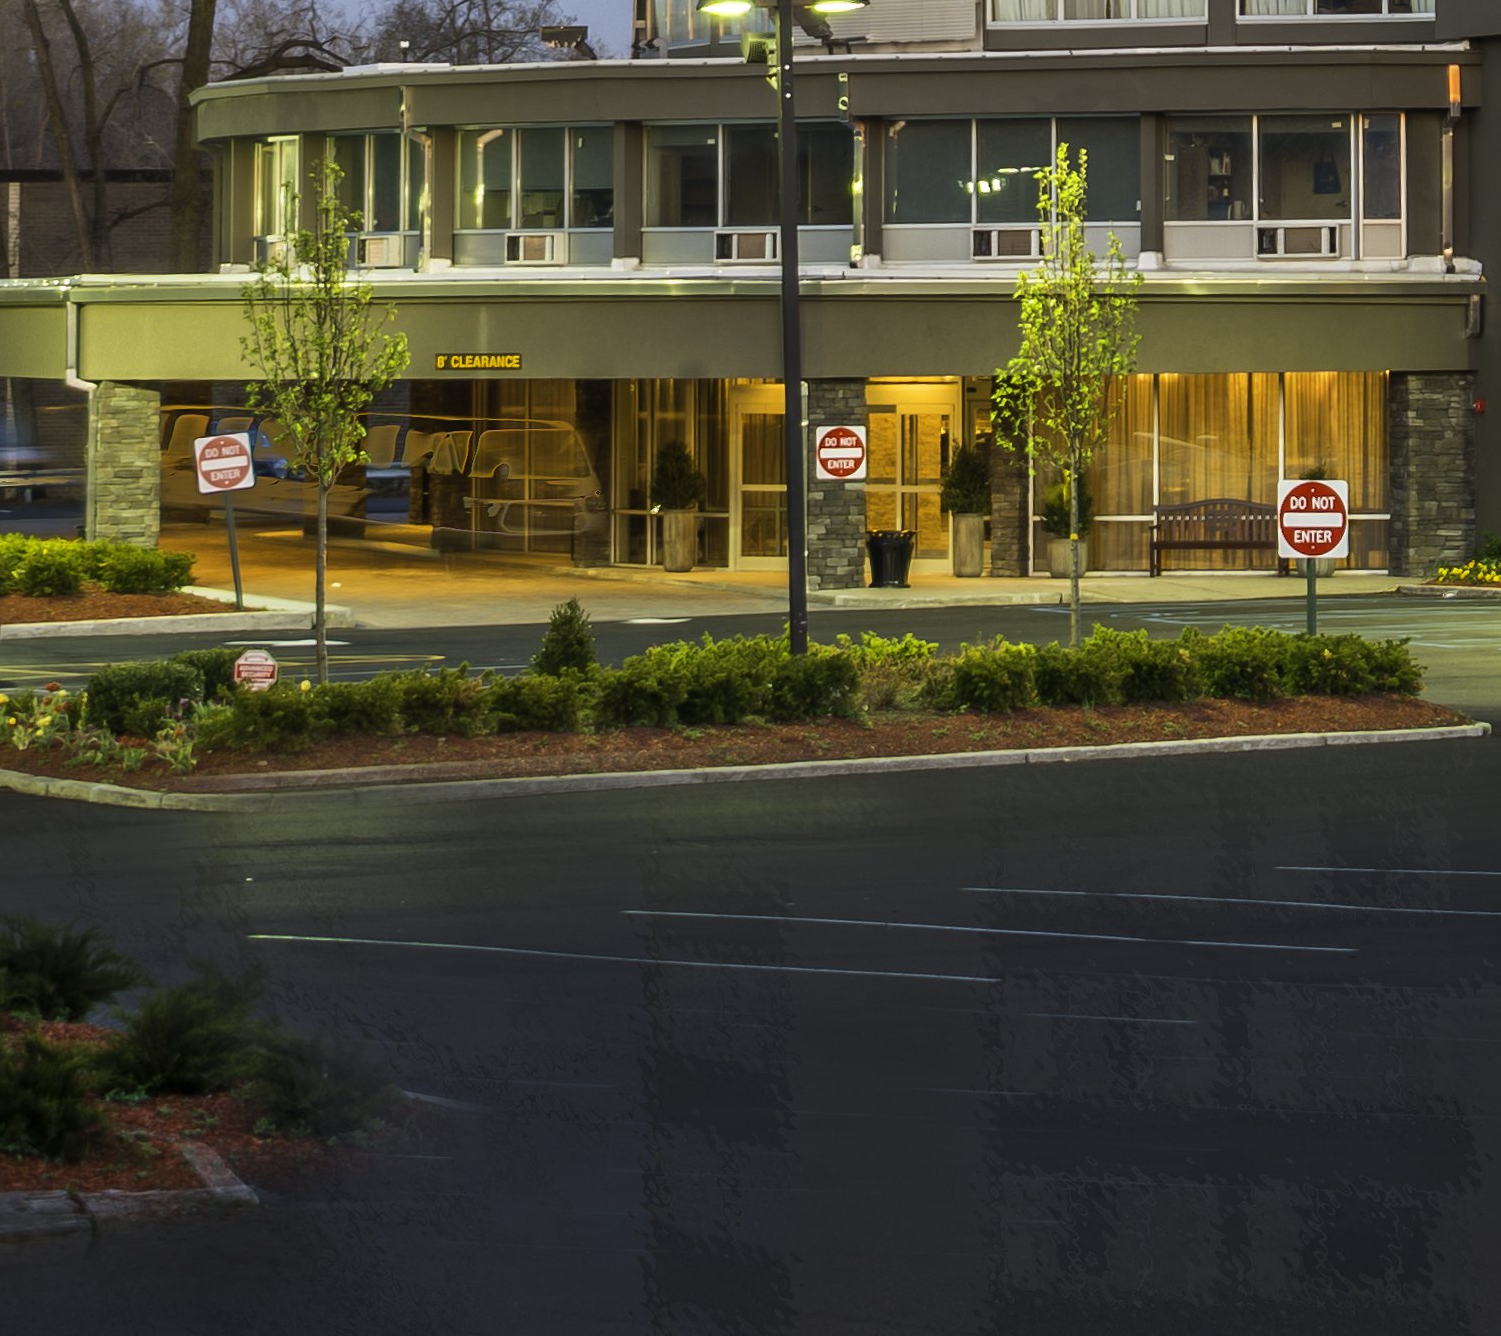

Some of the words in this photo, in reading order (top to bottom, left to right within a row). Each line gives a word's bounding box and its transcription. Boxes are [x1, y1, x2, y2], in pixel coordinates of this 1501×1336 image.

[450, 355, 520, 368] CLEARANCE
[825, 437, 838, 448] DO
[839, 436, 858, 448] NOT
[204, 448, 219, 459] DO
[221, 444, 240, 457] NOT
[827, 459, 856, 470] ENTER
[209, 468, 242, 482] ENTER
[1290, 495, 1307, 510] DO
[1311, 495, 1336, 510] NOT
[1293, 529, 1333, 544] ENTER
